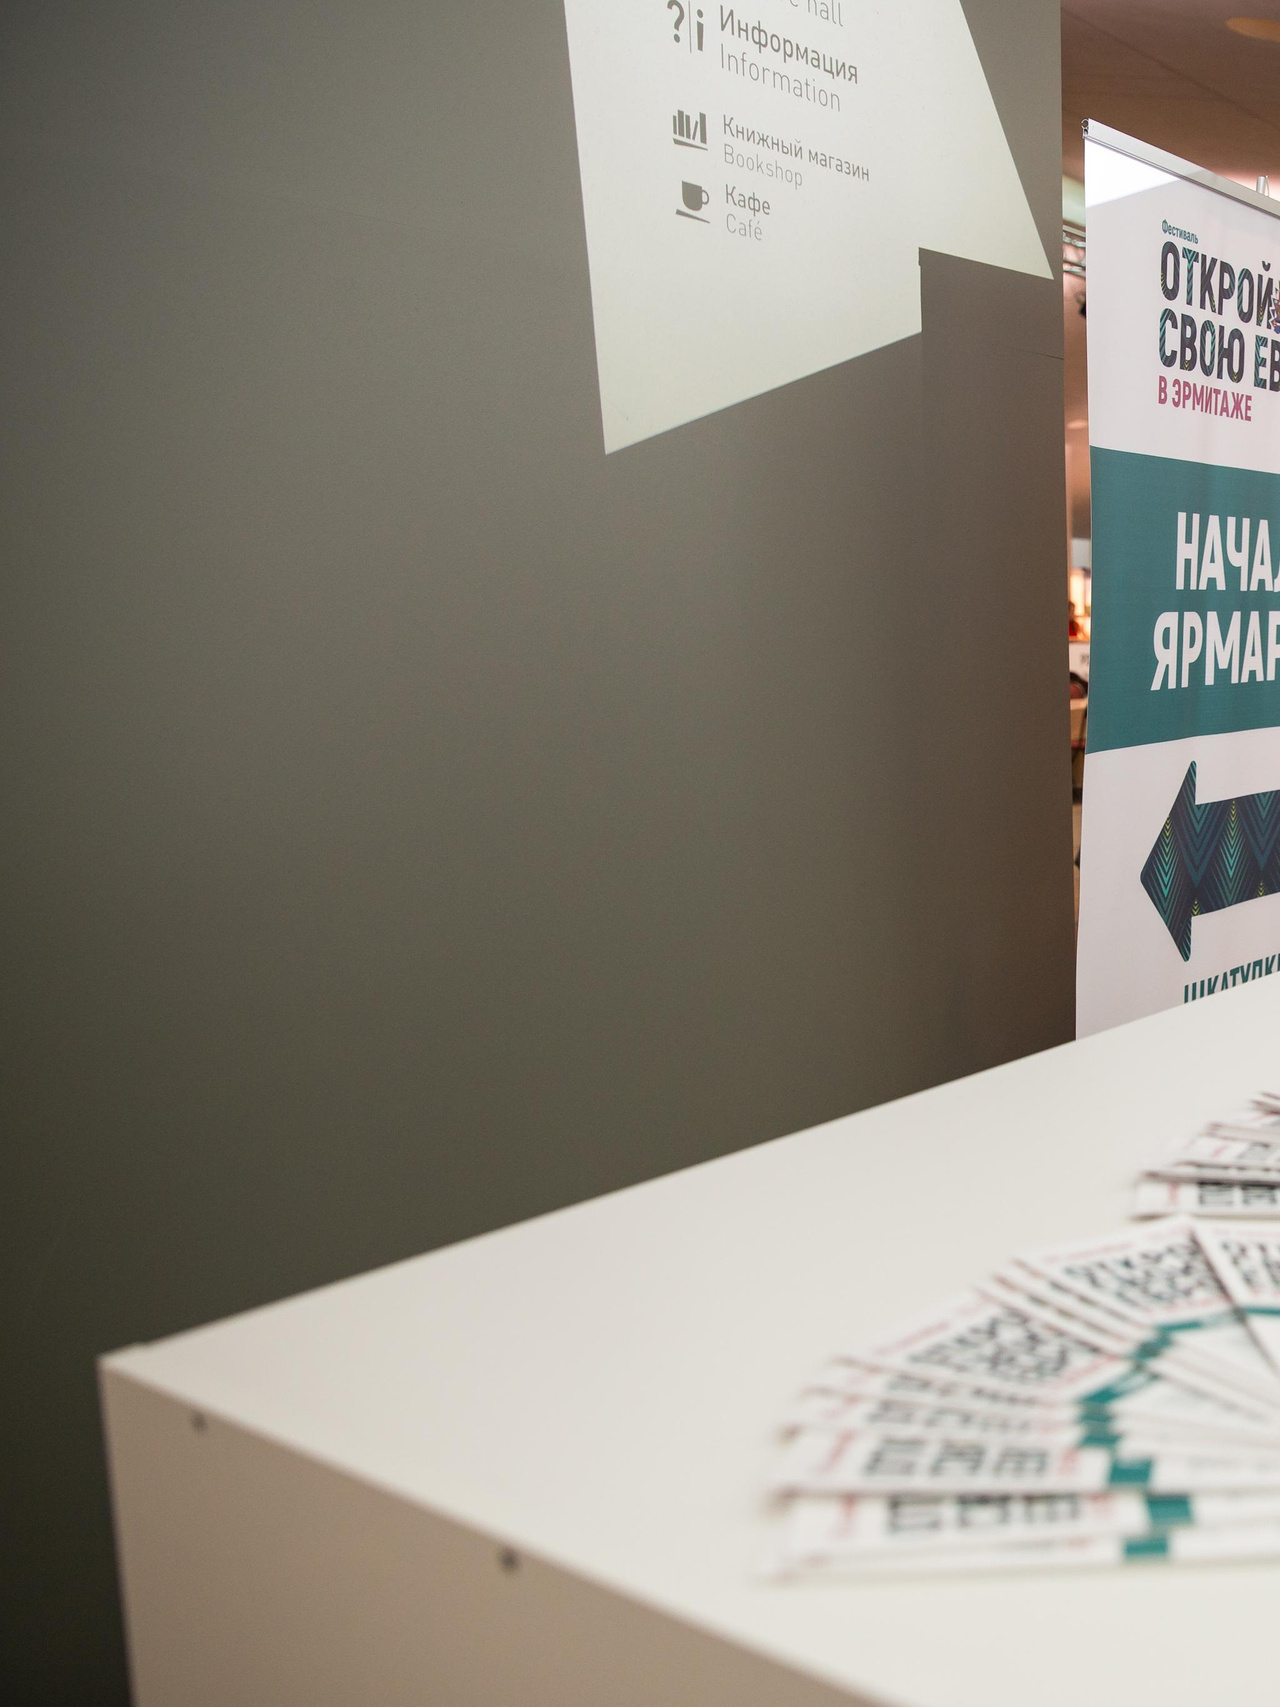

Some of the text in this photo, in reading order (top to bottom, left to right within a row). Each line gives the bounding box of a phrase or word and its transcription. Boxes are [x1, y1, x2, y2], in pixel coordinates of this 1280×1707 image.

[720, 4, 859, 84] Информация
[721, 44, 841, 112] Information
[723, 114, 870, 183] Книжный магазин
[723, 143, 803, 190] Bookshop
[725, 183, 771, 217] Кафе
[726, 213, 763, 242] Café
[1161, 219, 1199, 245] Фестиваль
[1160, 241, 1274, 330] ОТКРОЙ
[1158, 307, 1245, 383] СВОЮ
[1158, 375, 1252, 422] В ЭРМИТАЖЕ
